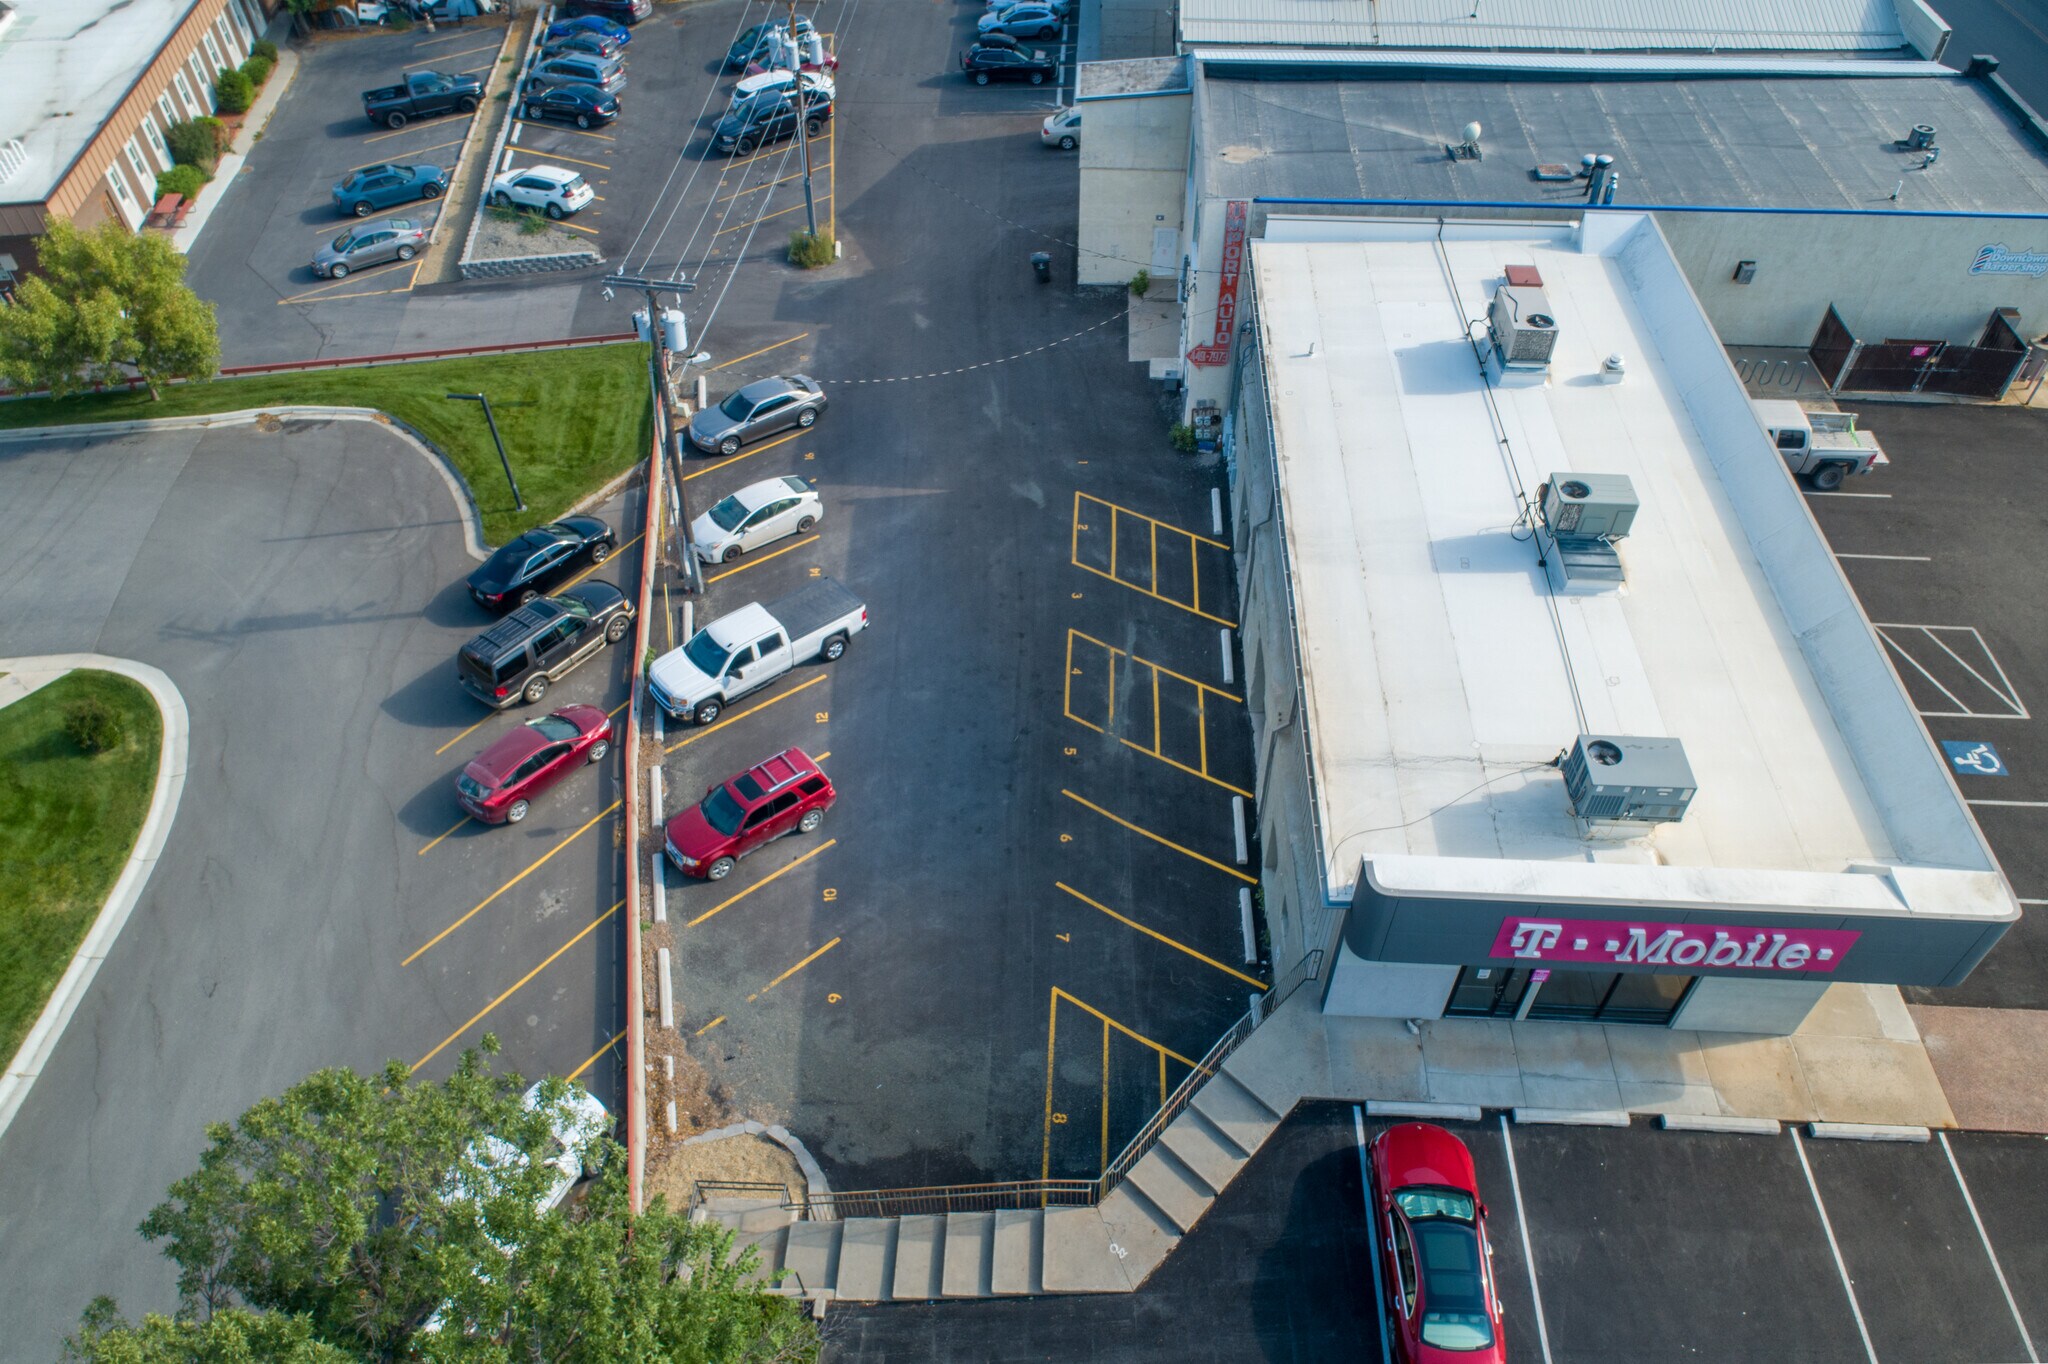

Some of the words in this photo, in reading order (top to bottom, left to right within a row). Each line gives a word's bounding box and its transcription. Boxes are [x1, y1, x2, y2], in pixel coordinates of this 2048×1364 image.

[1223, 202, 1247, 286] IMPORT
[1992, 254, 2048, 264] Downtown
[2020, 262, 2047, 274] shop
[1216, 294, 1234, 344] AUTO
[1077, 523, 1089, 531] 2
[808, 567, 821, 577] 14
[1070, 667, 1083, 676] 4
[815, 711, 829, 724] 12
[1063, 747, 1077, 756] 5
[1059, 833, 1073, 843] 6
[822, 888, 838, 903] 10
[1055, 932, 1070, 943] 7
[827, 992, 842, 1004] 9
[1052, 1112, 1067, 1124] 8
